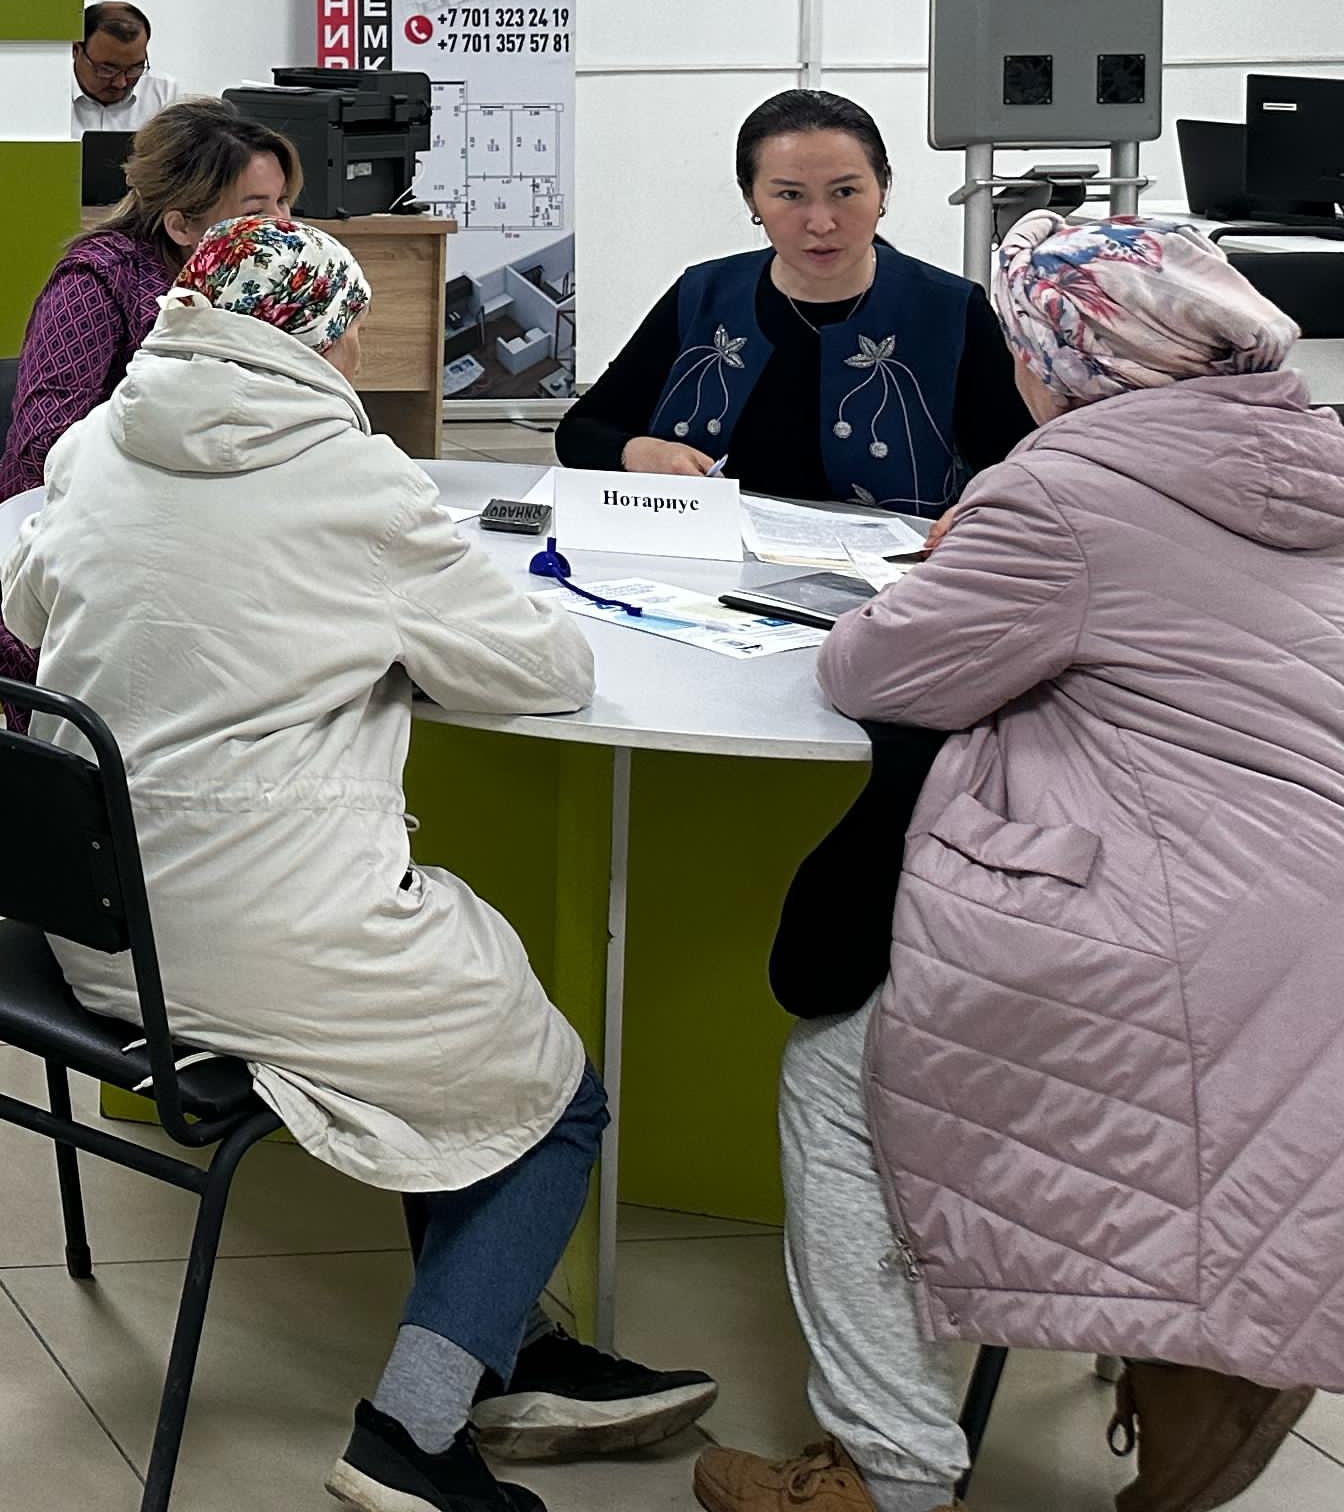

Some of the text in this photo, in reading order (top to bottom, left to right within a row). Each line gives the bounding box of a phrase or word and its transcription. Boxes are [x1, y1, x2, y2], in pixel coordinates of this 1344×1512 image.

[437, 8, 569, 28] +7 701 323 24 19
[437, 33, 570, 53] +7 701 357 57 81
[602, 489, 700, 513] Нотариус
